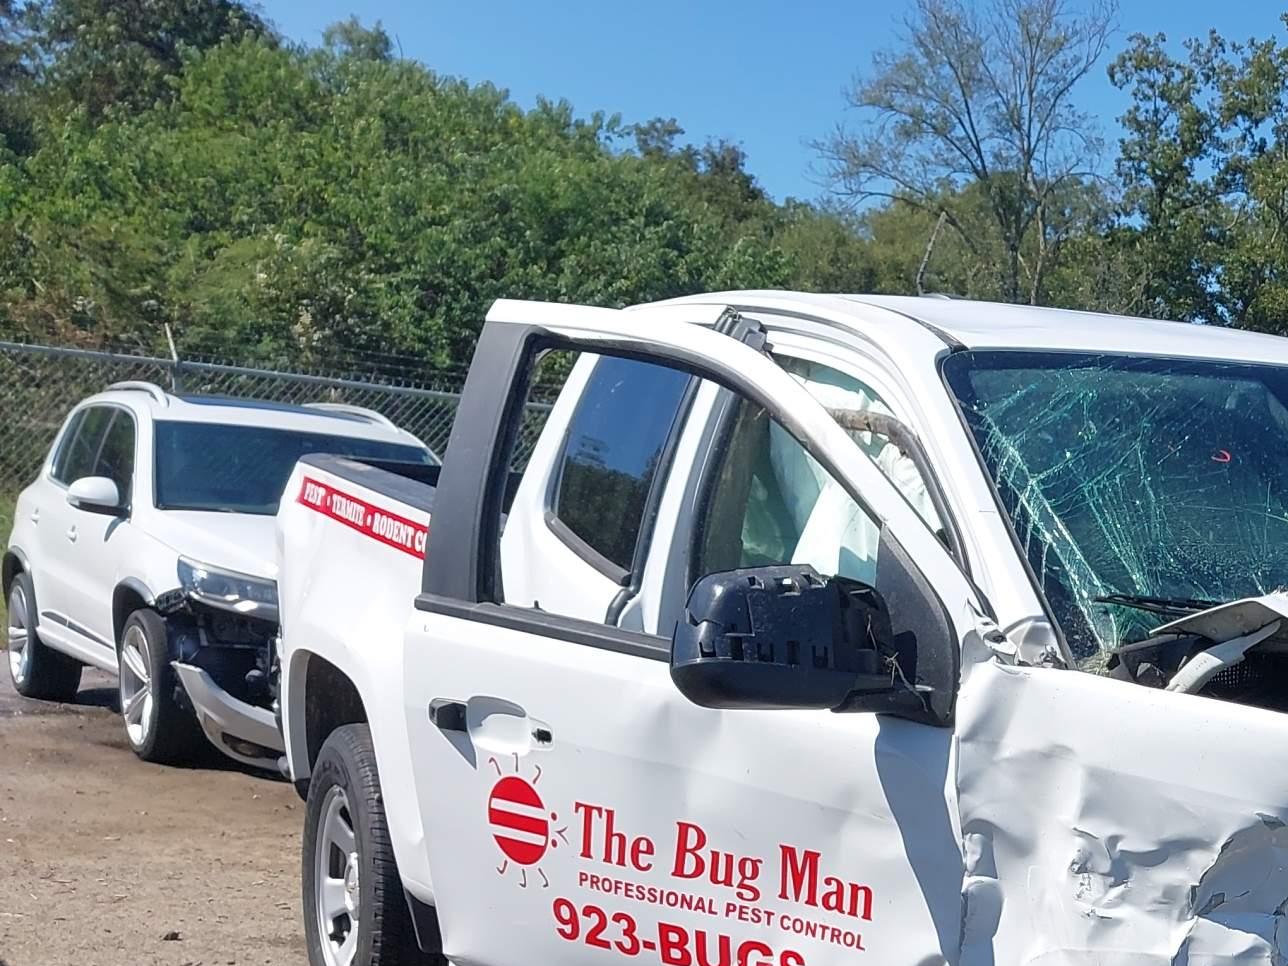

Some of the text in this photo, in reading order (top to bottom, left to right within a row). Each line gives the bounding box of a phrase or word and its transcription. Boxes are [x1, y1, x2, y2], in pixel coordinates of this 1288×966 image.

[303, 482, 326, 506] PEST
[332, 493, 365, 527] TERMITE
[372, 512, 414, 549] RODENT
[574, 801, 873, 921] The Bug Man
[578, 871, 866, 951] PROFESSIONAL PEST CONTROL
